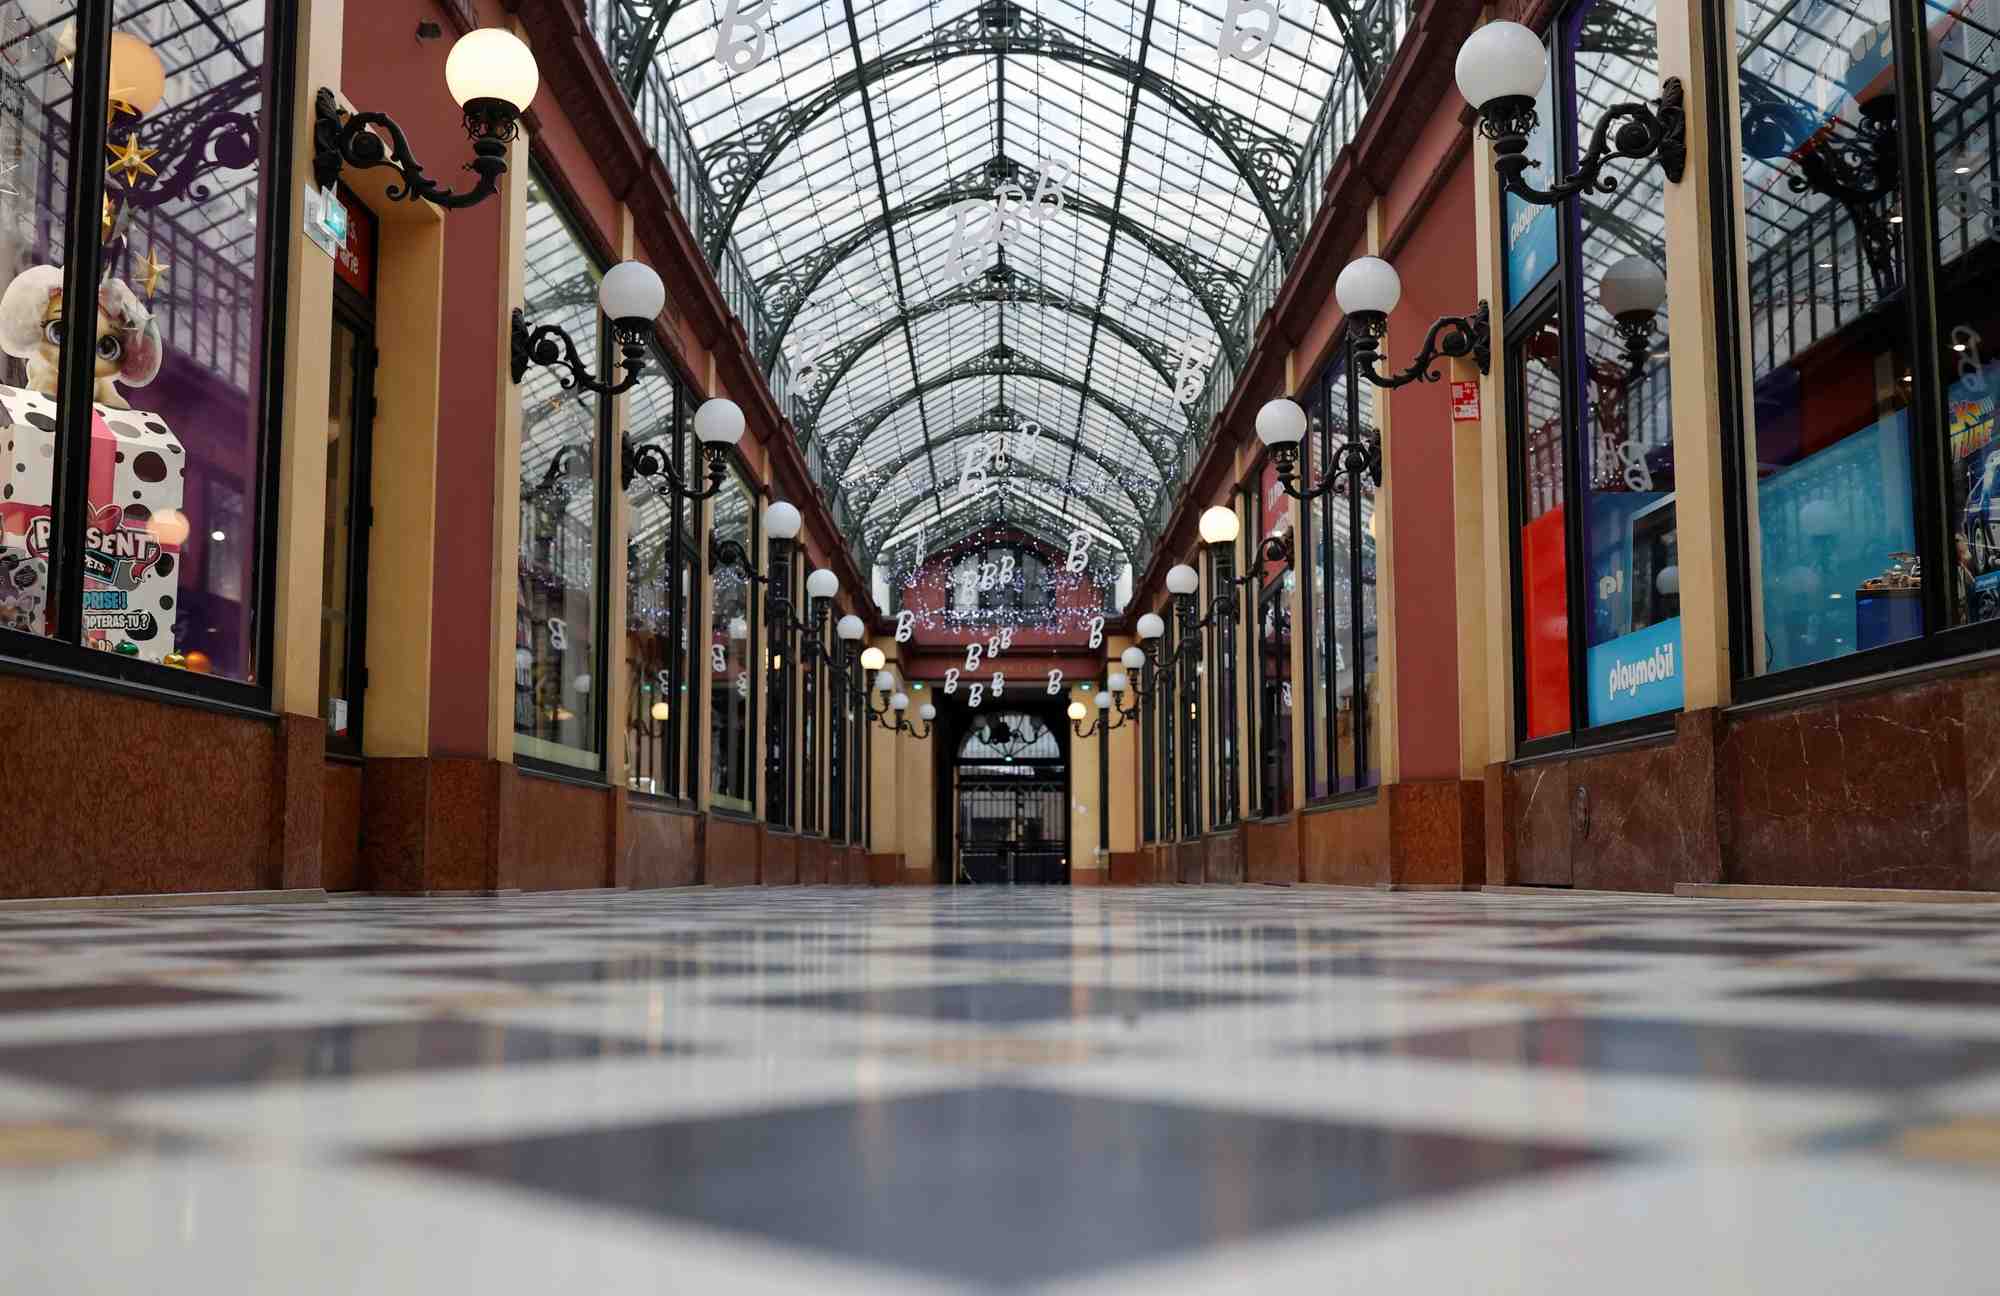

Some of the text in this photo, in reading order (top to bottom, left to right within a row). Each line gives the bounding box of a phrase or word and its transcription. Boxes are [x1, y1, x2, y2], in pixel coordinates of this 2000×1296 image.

[1174, 334, 1210, 405] B
[1066, 530, 1091, 573] B
[980, 563, 997, 591] B
[895, 610, 915, 643] B
[1089, 616, 1104, 649] B
[966, 643, 983, 672] B
[1608, 642, 1675, 701] playmobil
[944, 668, 960, 694] B
[968, 683, 983, 708] B
[1047, 669, 1063, 695] B
